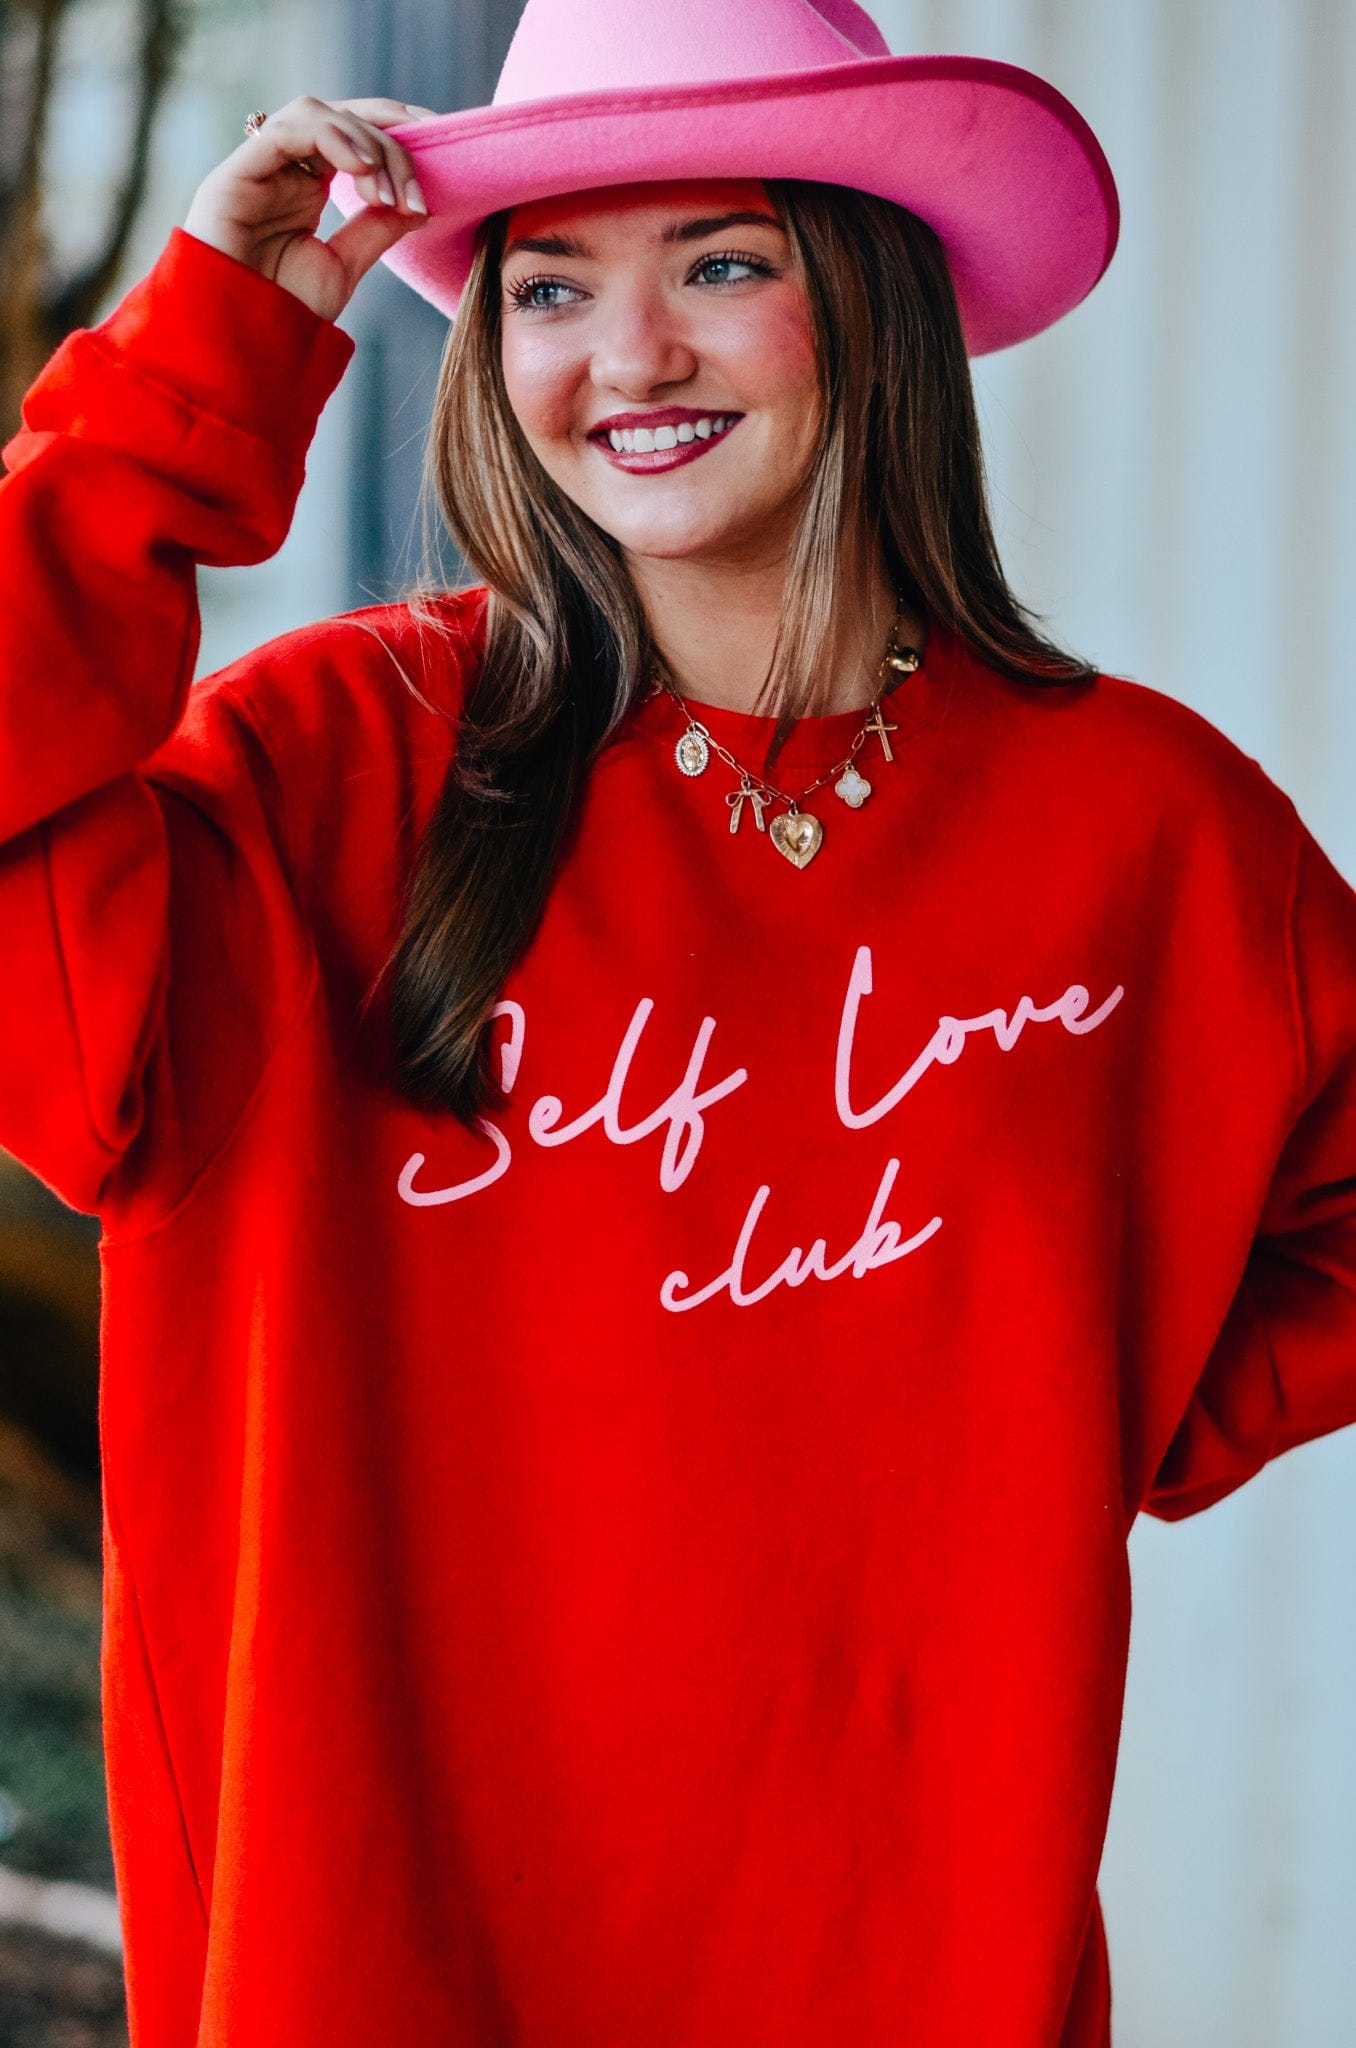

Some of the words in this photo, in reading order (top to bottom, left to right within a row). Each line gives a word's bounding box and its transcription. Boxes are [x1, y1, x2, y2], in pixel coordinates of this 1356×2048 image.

[397, 999, 748, 1208] Self
[834, 945, 1124, 1130] Love
[659, 1157, 943, 1313] club
